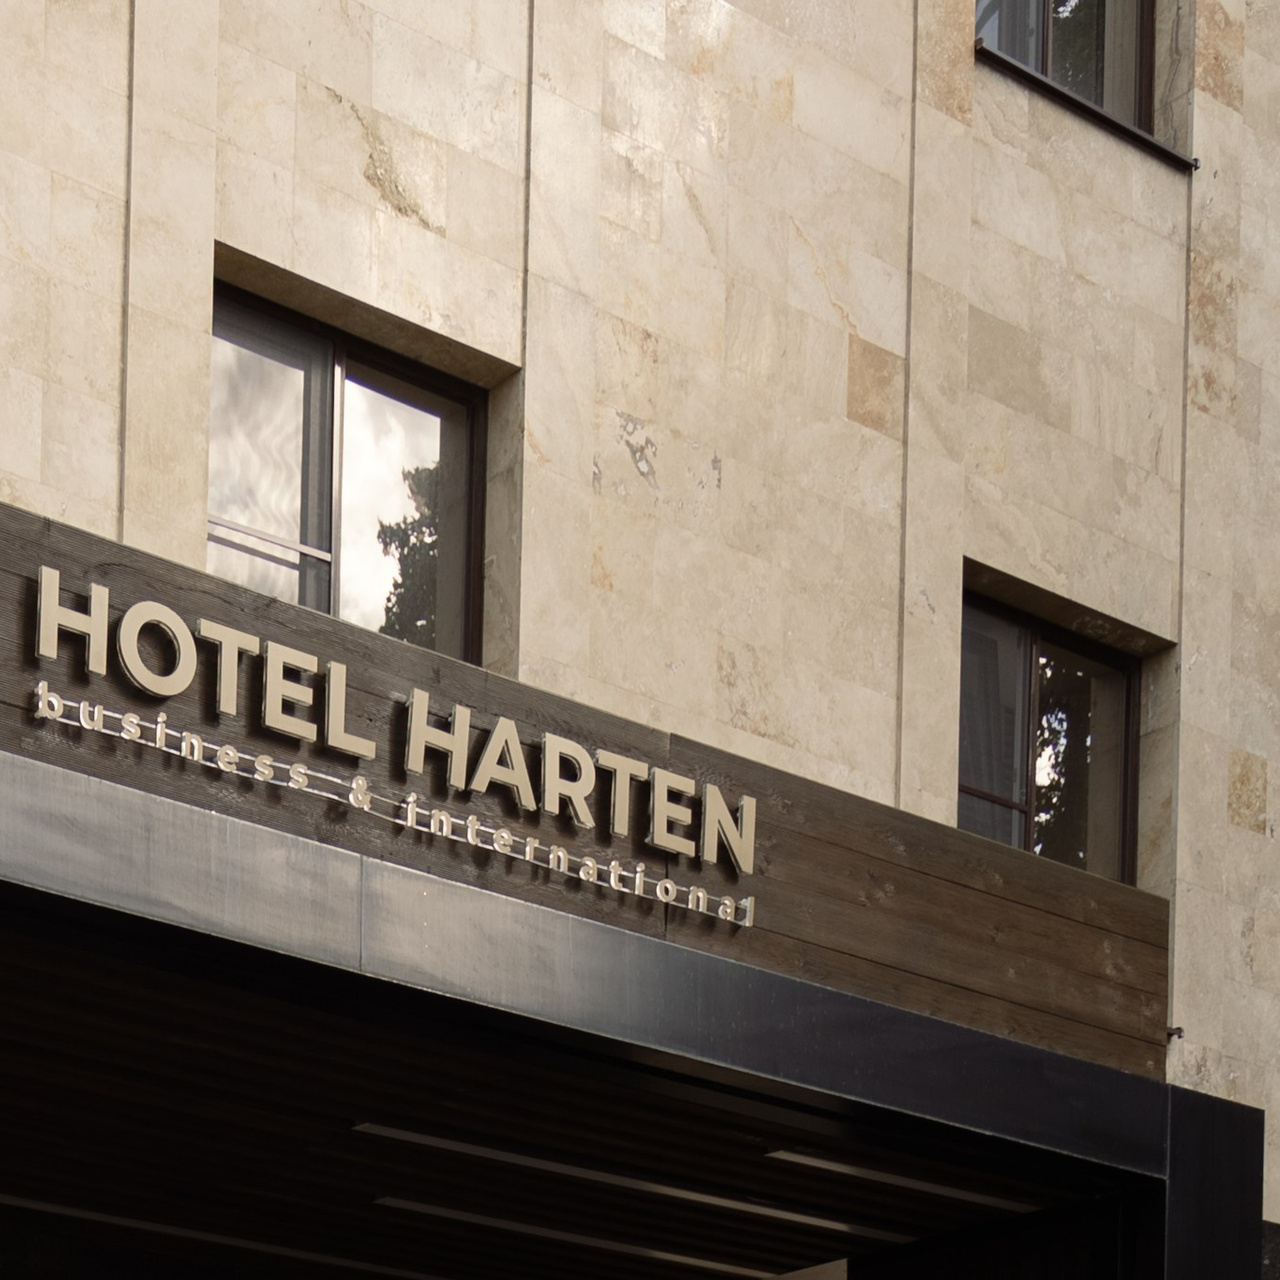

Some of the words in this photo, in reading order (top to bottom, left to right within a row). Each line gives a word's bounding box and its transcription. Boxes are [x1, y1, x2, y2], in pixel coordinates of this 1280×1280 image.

[35, 565, 376, 760] HOTEL
[405, 687, 757, 875] HARTEN
[35, 681, 308, 789] business
[349, 776, 372, 811] &
[406, 792, 755, 927] international
